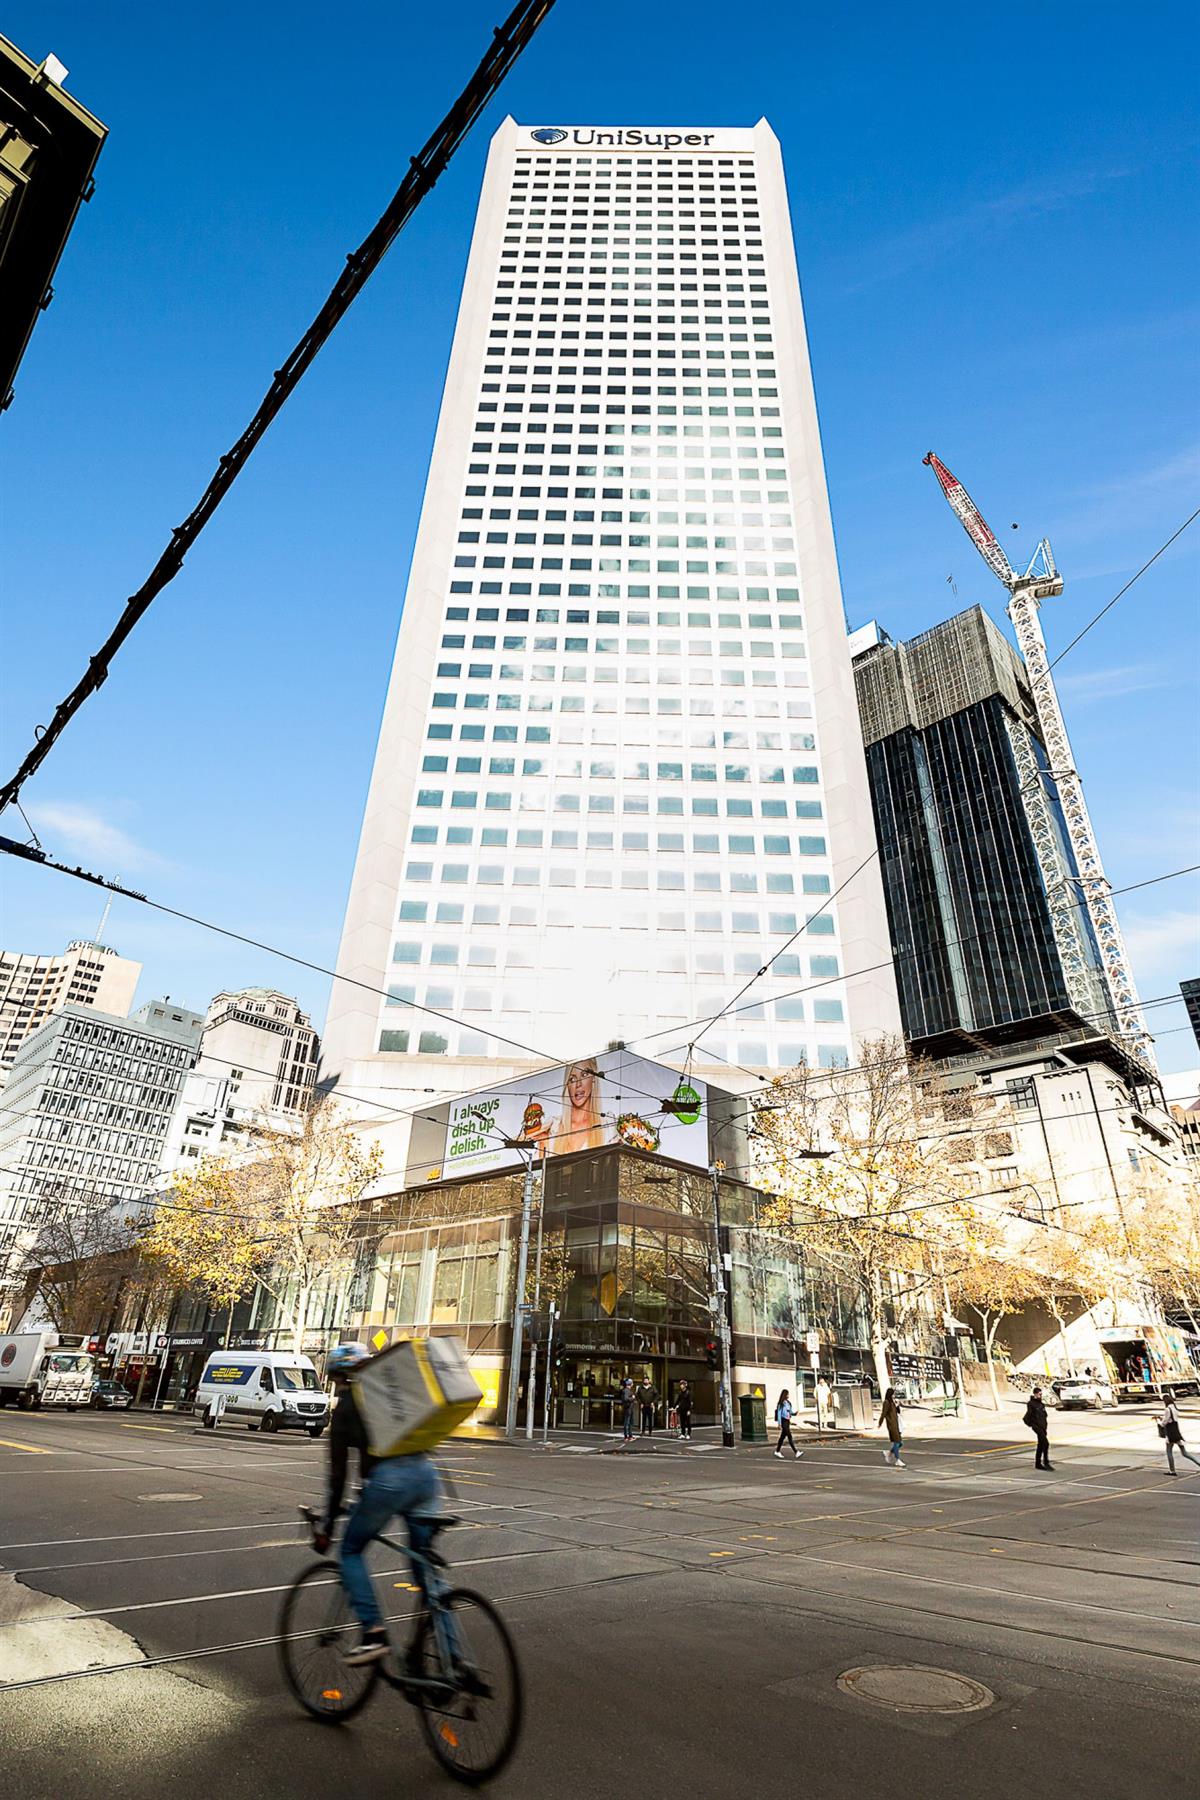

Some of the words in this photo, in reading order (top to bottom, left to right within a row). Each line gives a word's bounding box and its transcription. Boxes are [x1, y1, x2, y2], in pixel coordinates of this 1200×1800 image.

[573, 129, 715, 150] UniSuper
[453, 1108, 458, 1121] I
[460, 1098, 500, 1119] always
[451, 1120, 476, 1138] dish
[479, 1117, 495, 1133] up
[450, 1136, 487, 1156] delish.
